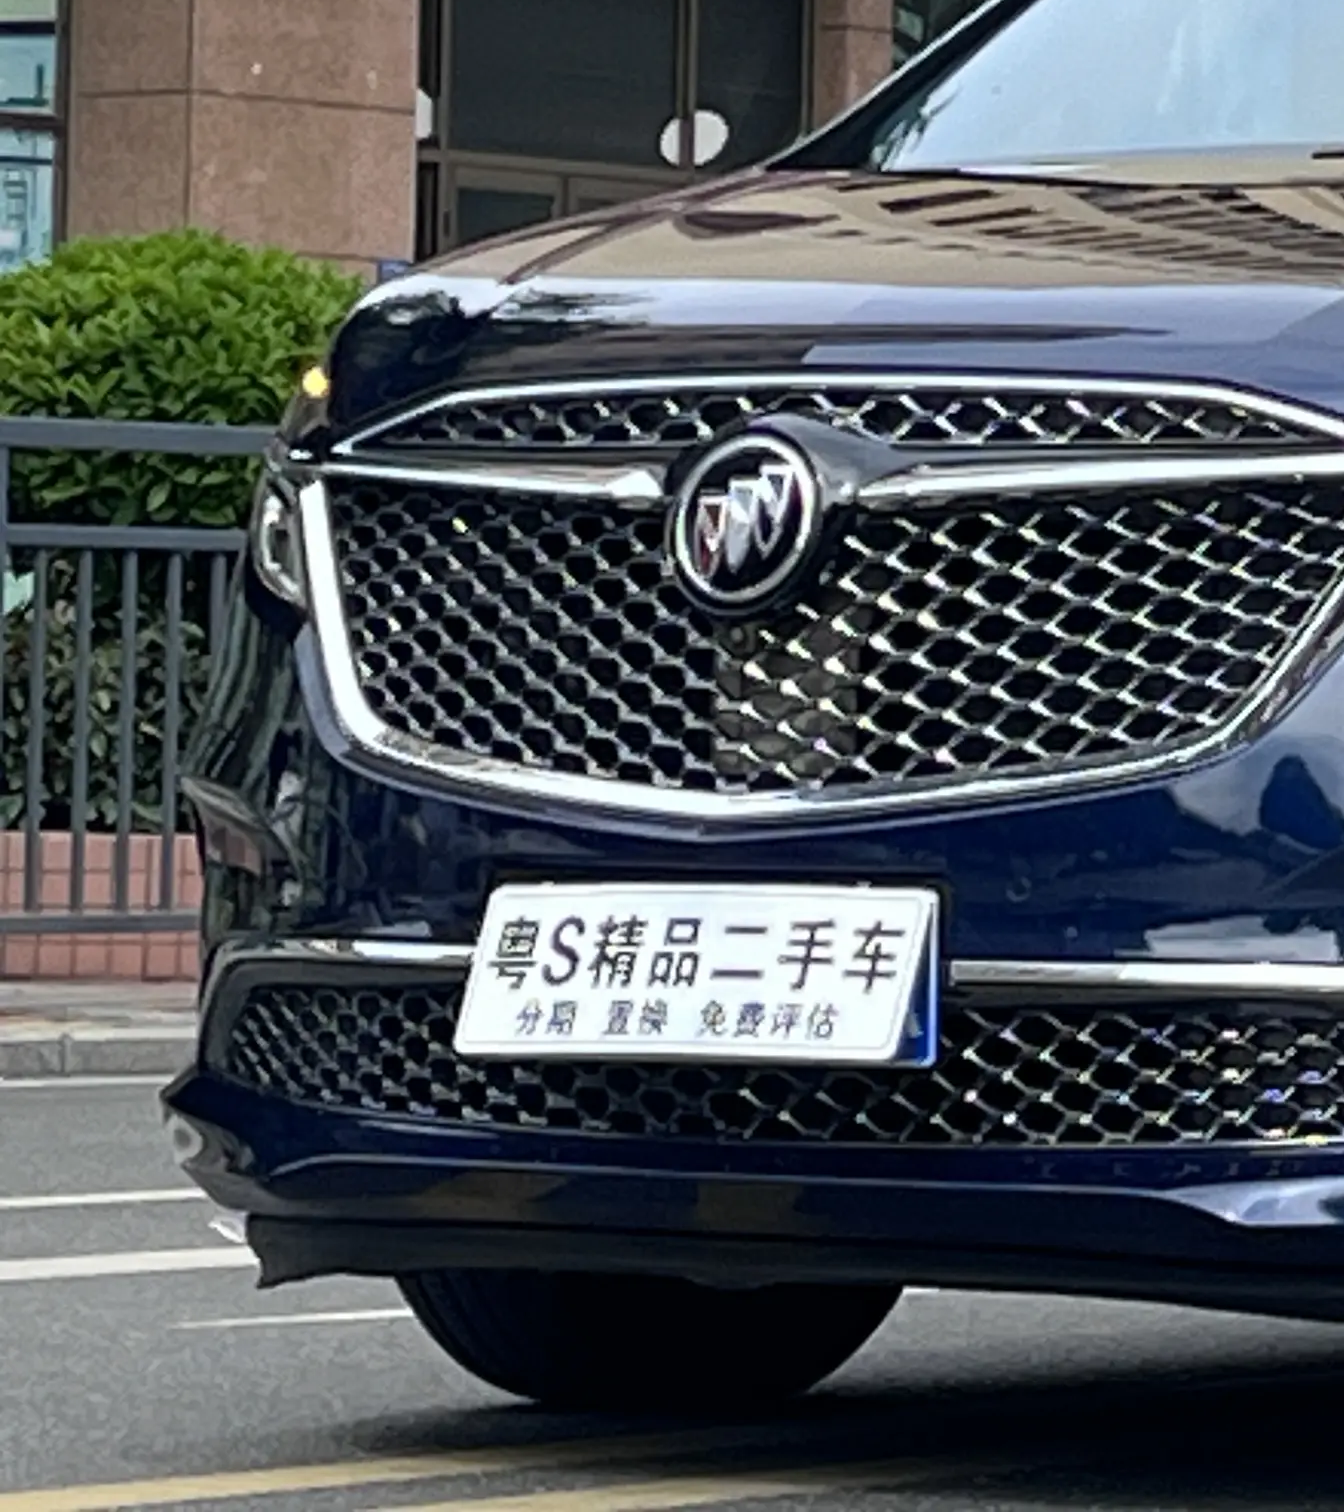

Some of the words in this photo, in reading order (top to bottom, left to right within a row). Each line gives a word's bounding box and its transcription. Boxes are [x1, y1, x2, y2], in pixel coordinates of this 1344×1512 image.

[488, 916, 905, 992] 粤S精品二手车
[699, 1000, 839, 1041] 免费评估
